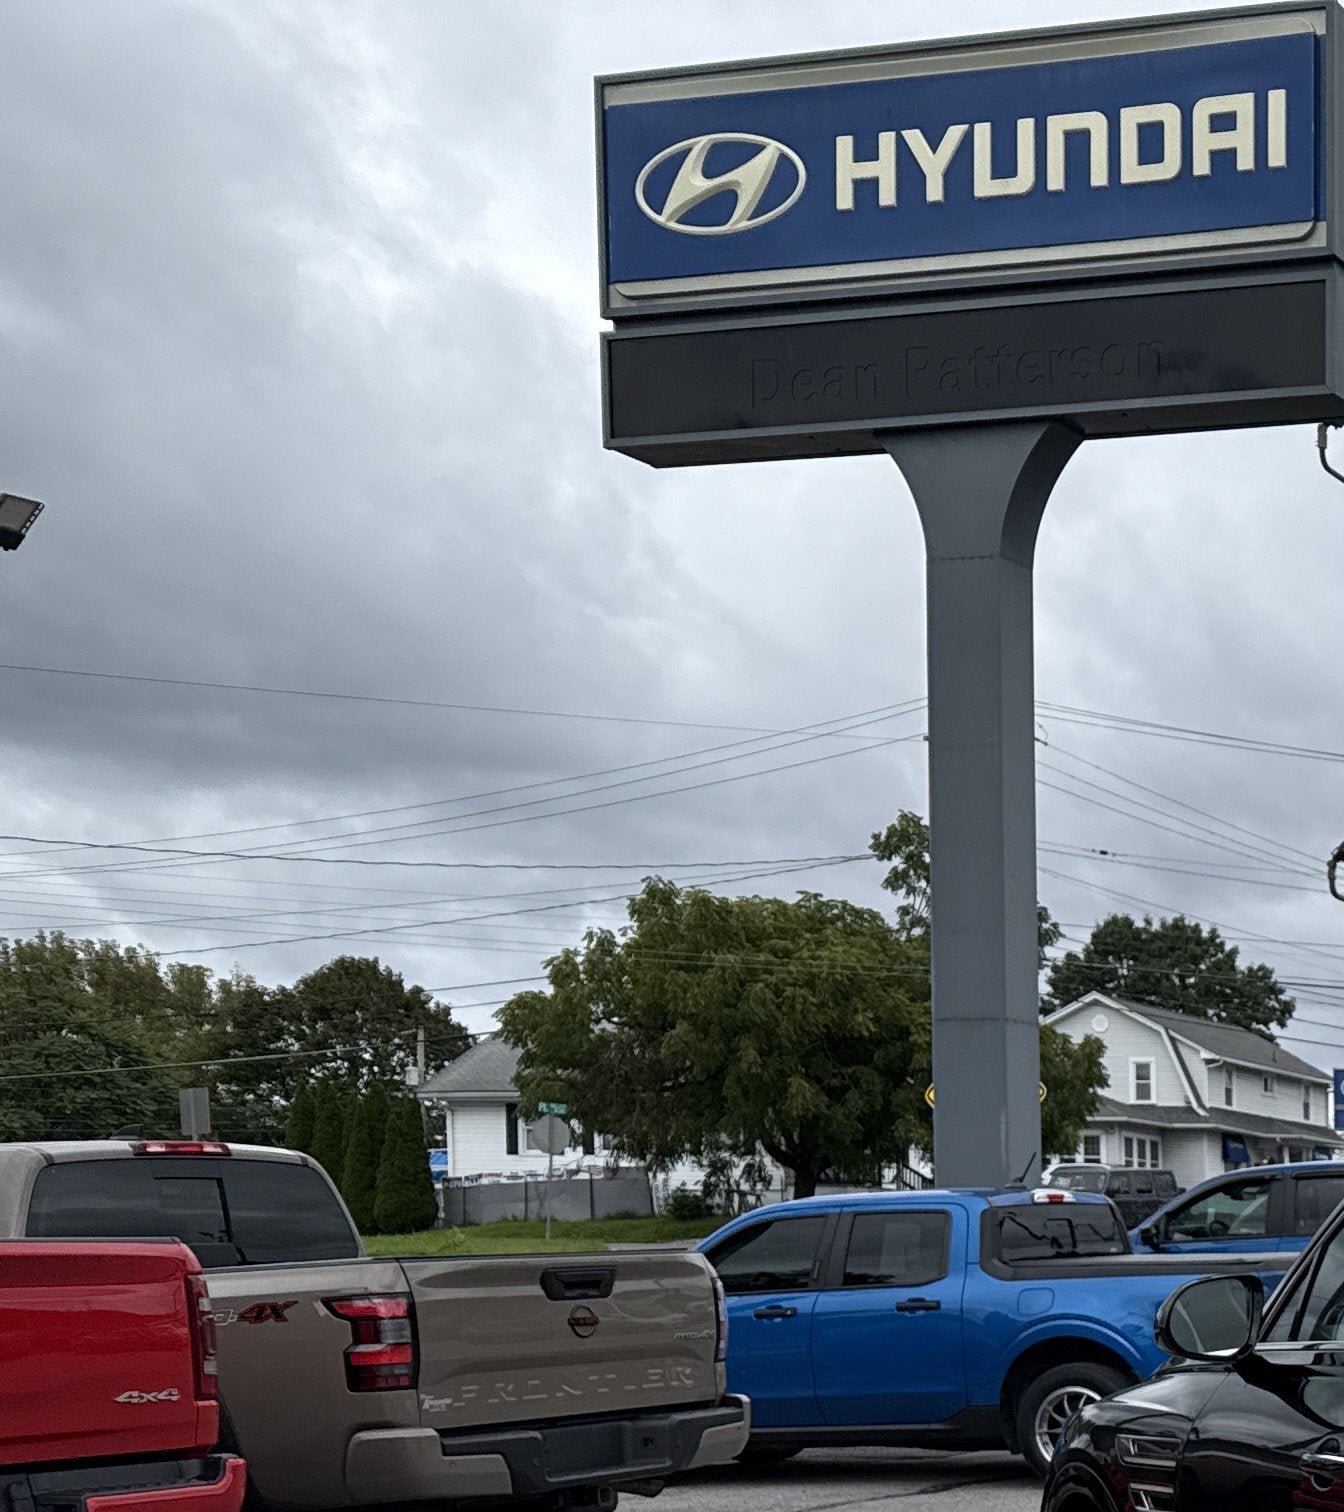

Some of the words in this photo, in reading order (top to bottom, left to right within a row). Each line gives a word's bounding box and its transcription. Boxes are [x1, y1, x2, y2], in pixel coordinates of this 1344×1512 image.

[835, 88, 1288, 210] HYUNDAI
[750, 358, 879, 408] Dean
[903, 340, 1168, 396] Patterson
